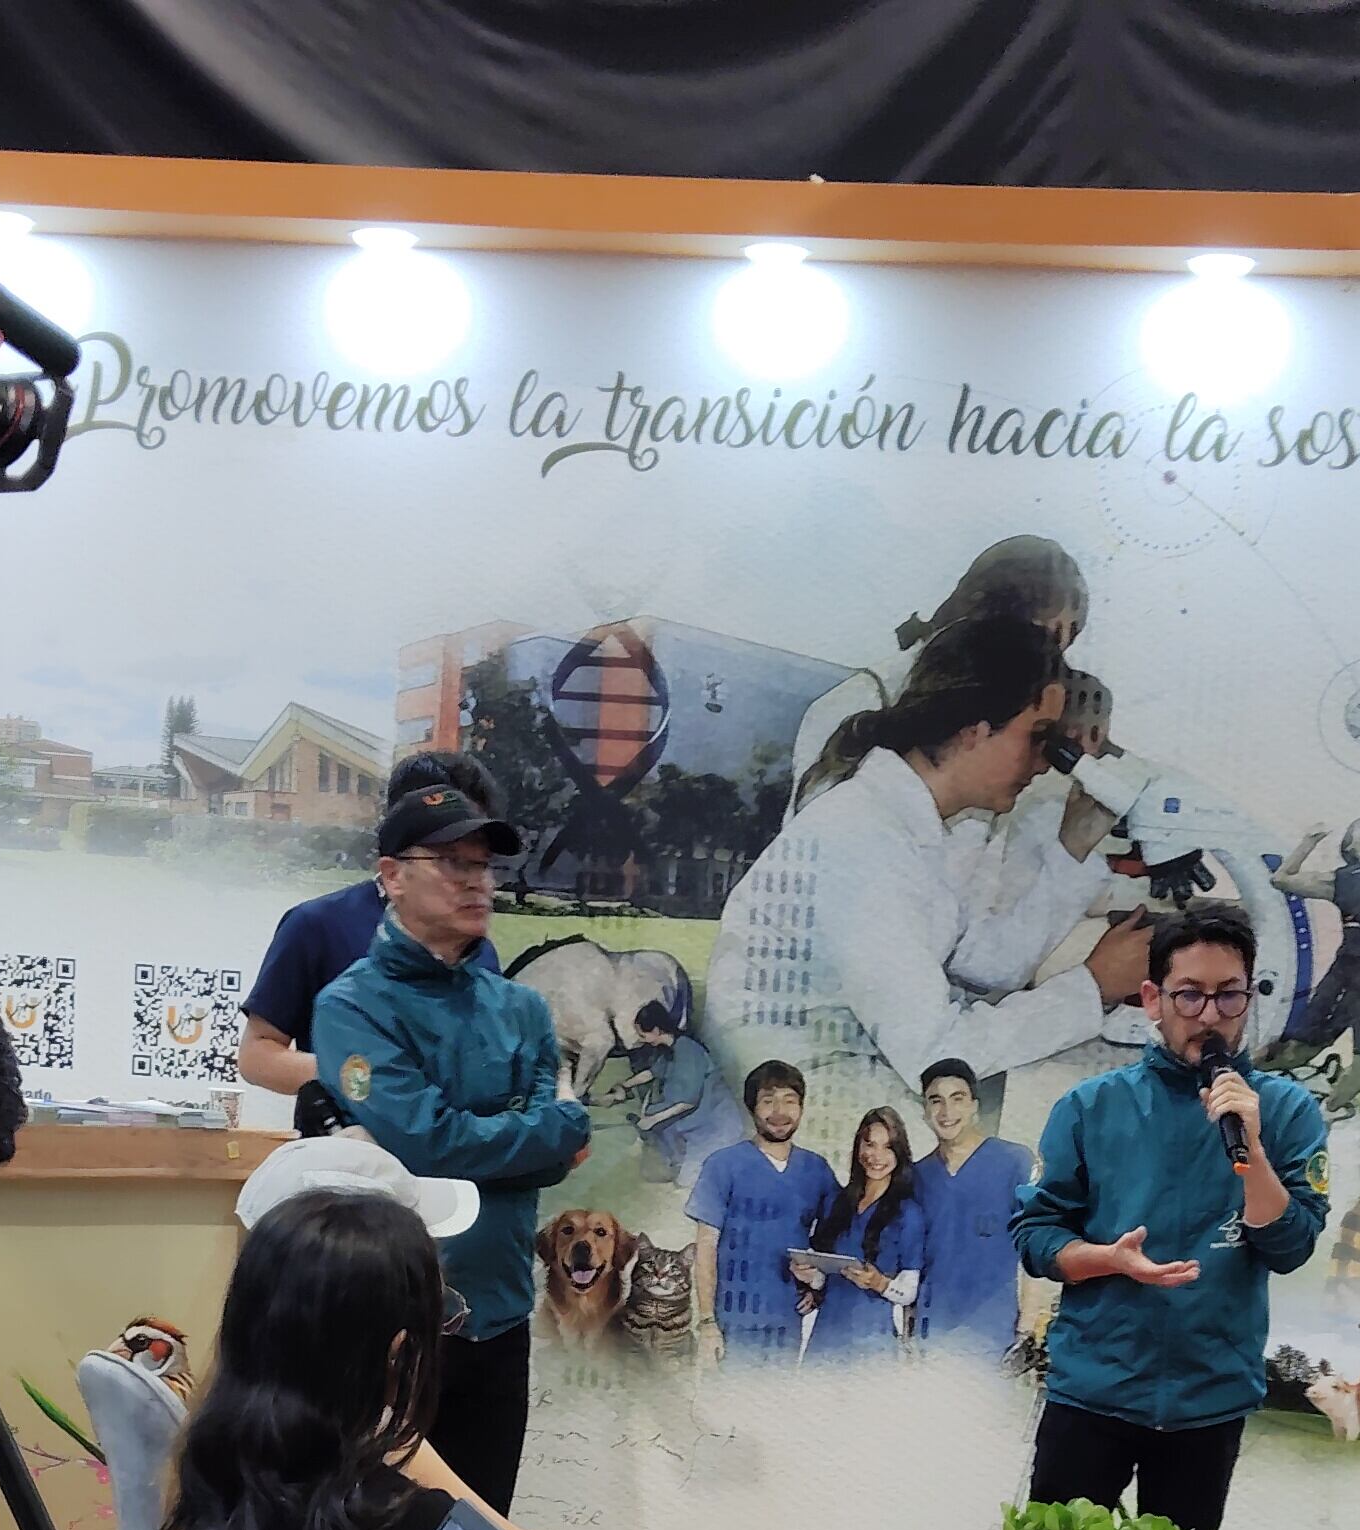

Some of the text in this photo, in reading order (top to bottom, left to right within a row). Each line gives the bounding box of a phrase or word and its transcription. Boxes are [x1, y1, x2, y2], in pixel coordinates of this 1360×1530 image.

[67, 331, 485, 450] Promovemos
[508, 369, 584, 440] la
[540, 371, 928, 478] transición
[947, 384, 1142, 460] hacia
[1163, 393, 1245, 464] la
